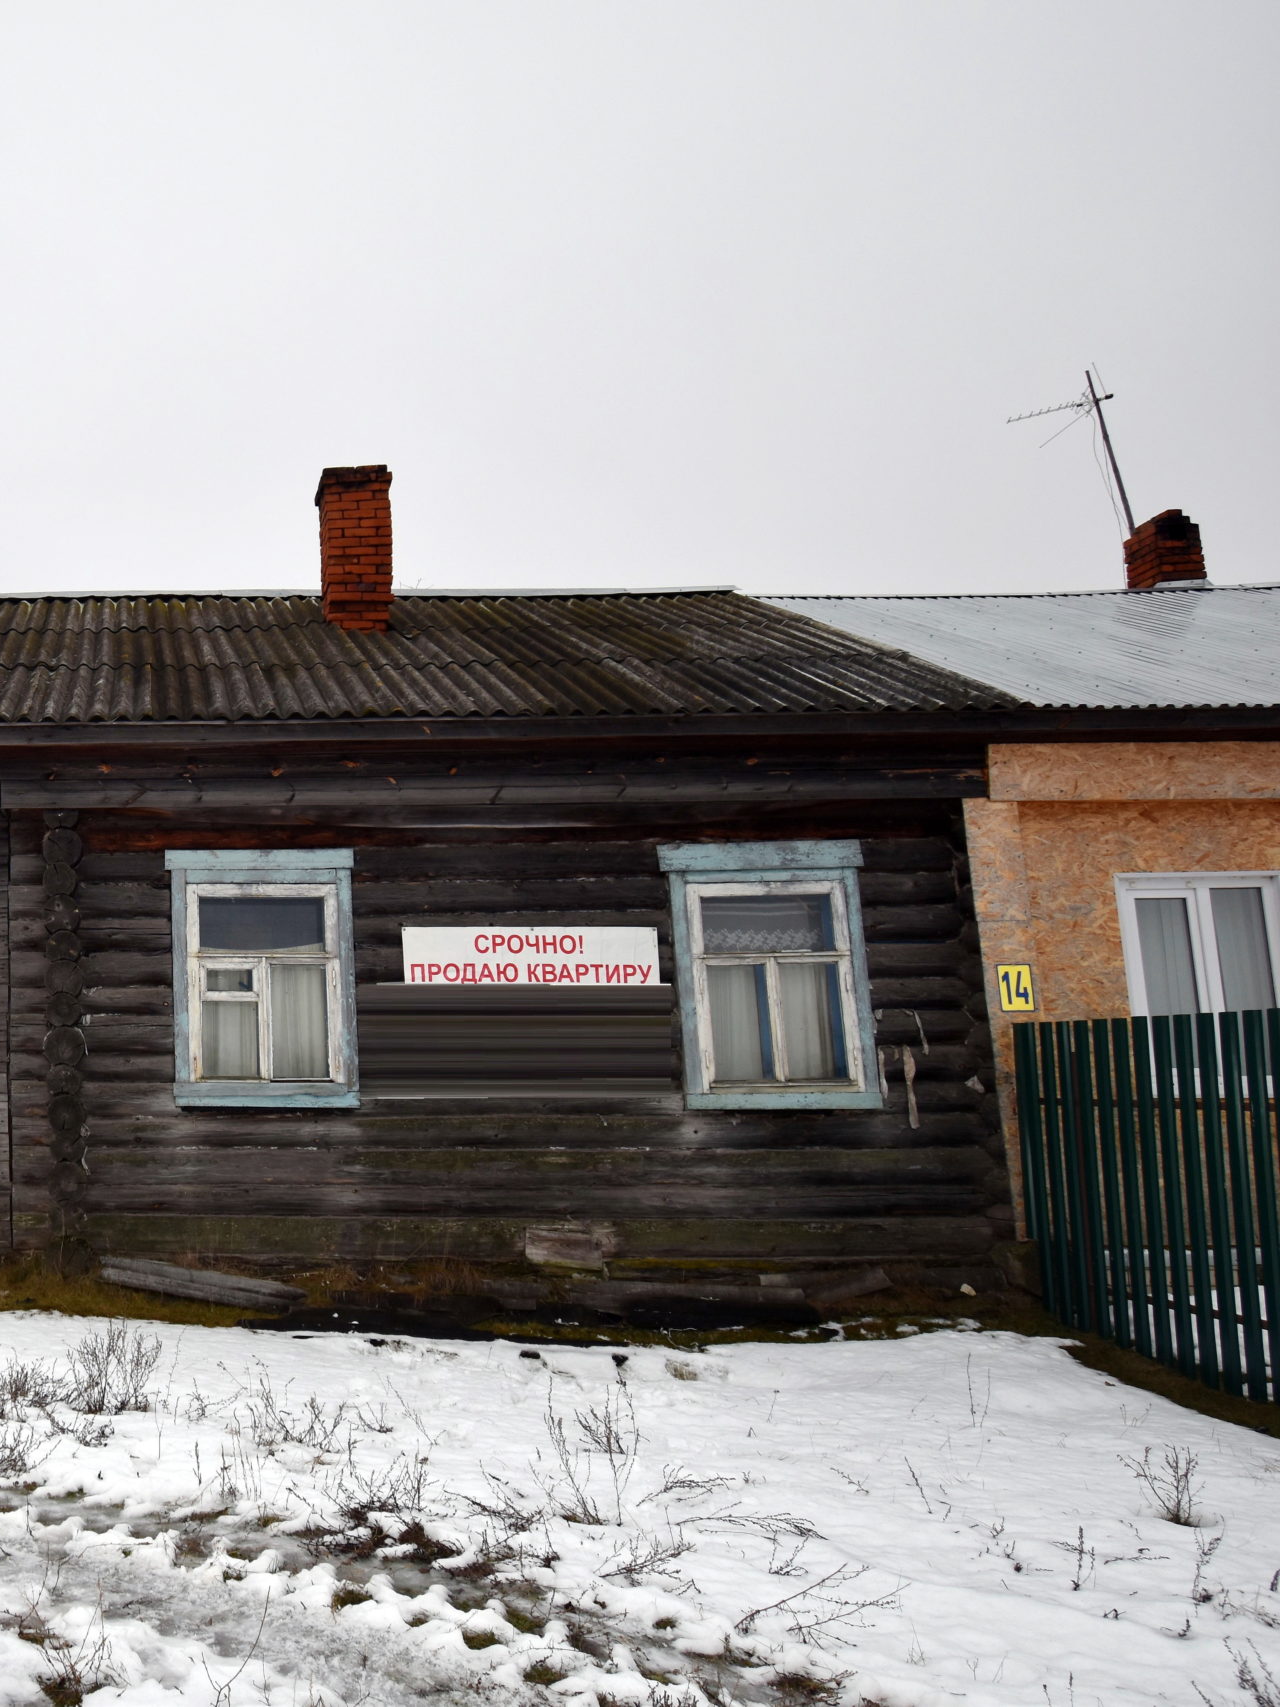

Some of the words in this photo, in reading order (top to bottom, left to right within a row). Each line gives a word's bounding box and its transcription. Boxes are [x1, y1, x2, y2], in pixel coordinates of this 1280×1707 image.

[474, 934, 584, 954] СРОЧНО!
[410, 963, 519, 984] ПРОДАЮ
[527, 963, 652, 984] КВАРТИРУ
[1001, 971, 1029, 1005] 14
